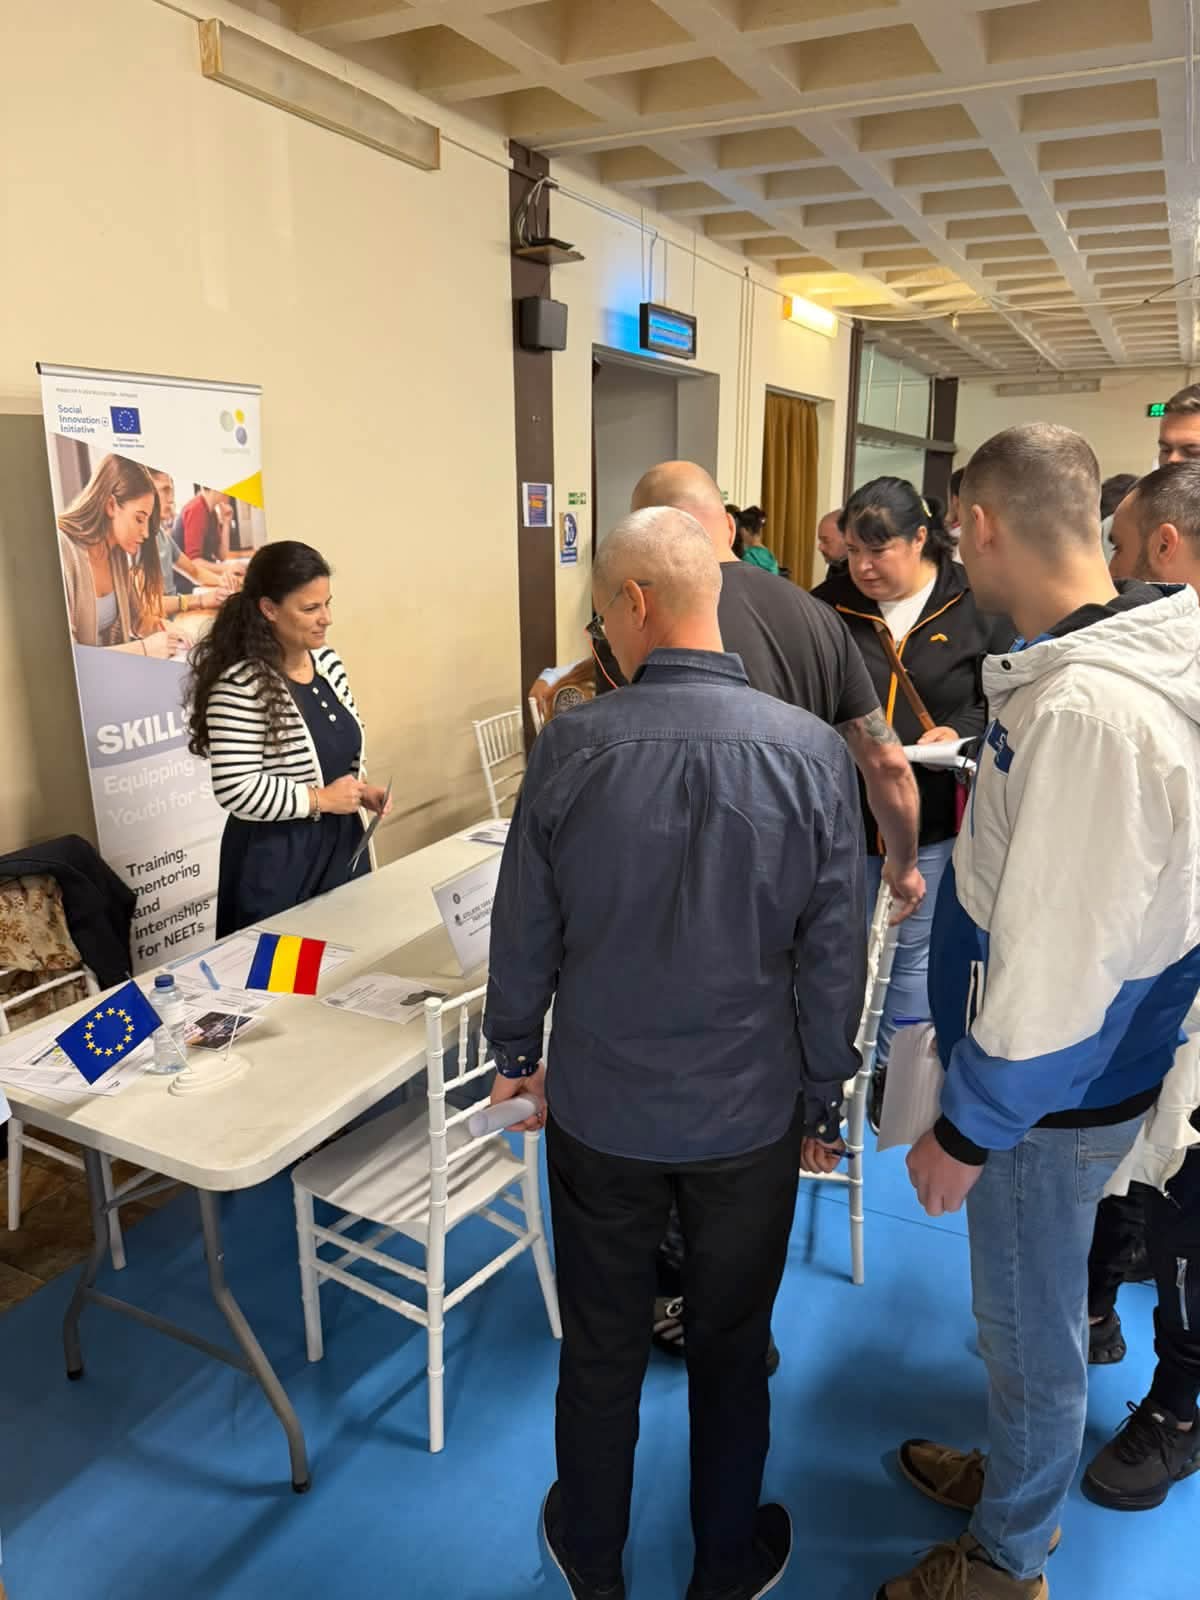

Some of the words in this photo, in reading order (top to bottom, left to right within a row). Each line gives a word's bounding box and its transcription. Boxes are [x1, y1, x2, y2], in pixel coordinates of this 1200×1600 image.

[57, 404, 82, 414] Social
[58, 414, 100, 424] Innovation
[60, 424, 95, 433] Initiative
[103, 759, 195, 796] Equipping
[107, 796, 168, 825] Youth
[170, 790, 196, 809] for
[134, 897, 160, 919] and
[135, 899, 210, 940] internships
[137, 942, 161, 959] for
[164, 921, 205, 949] NEETs
